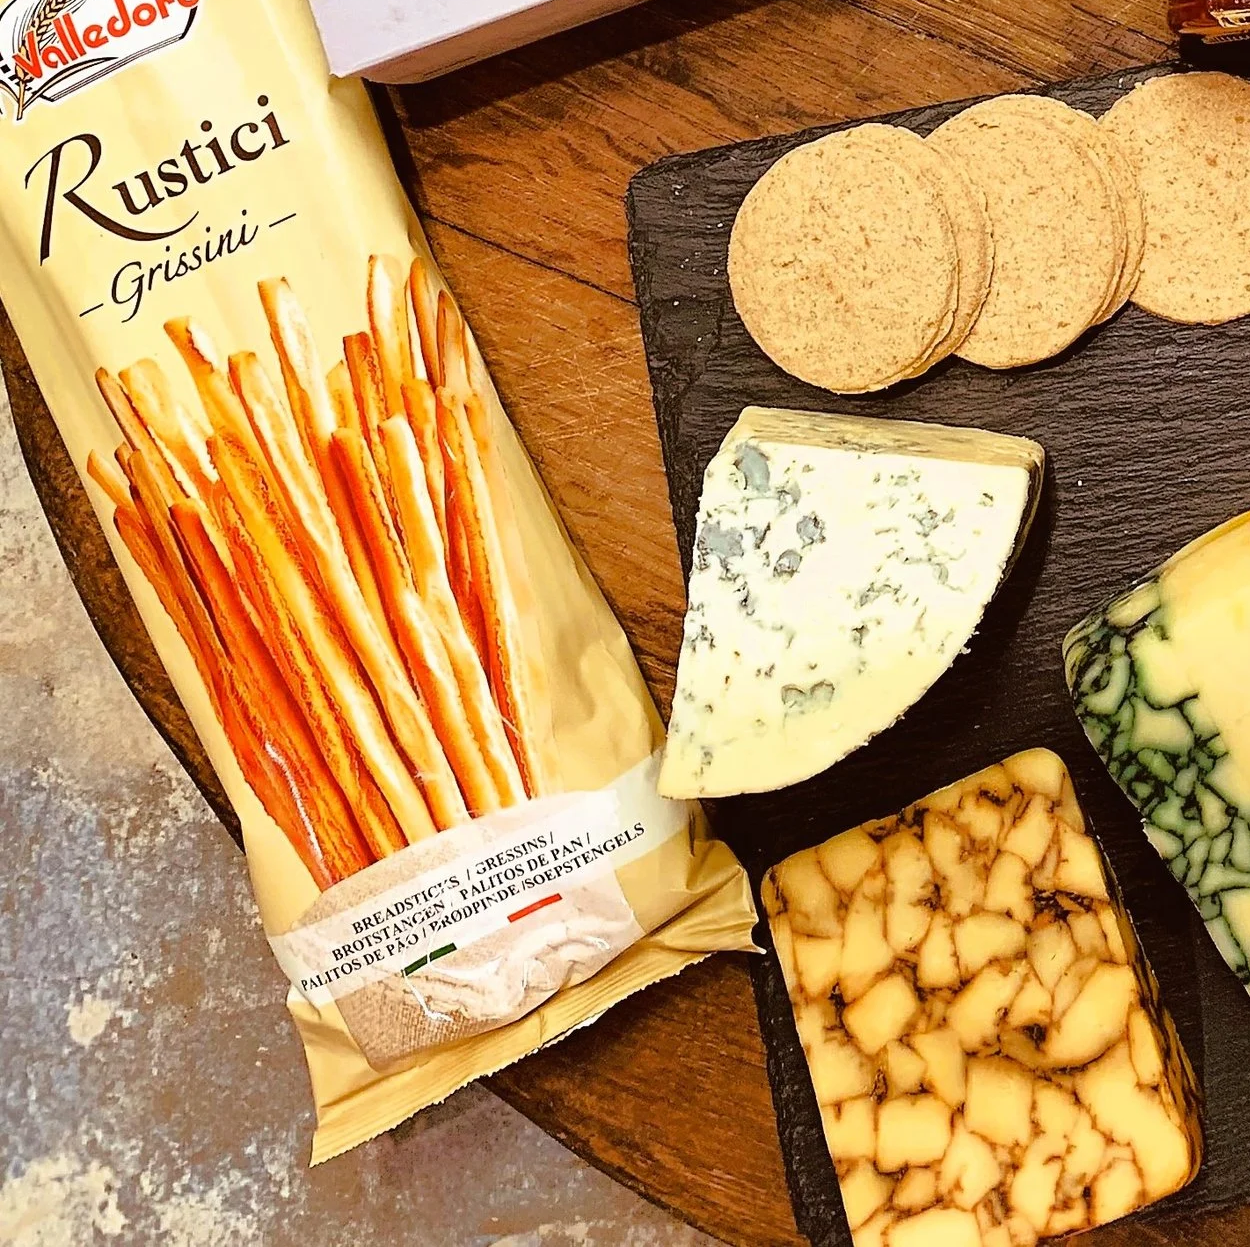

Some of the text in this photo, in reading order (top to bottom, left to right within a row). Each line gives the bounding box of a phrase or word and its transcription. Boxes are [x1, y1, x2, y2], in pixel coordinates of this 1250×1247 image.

[25, 94, 290, 267] Rustici
[110, 208, 259, 323] Grissini
[331, 899, 445, 961] BROTSTANGEN
[459, 866, 526, 901] PALITOS
[528, 855, 549, 876] DE
[551, 839, 585, 865] PAN
[352, 875, 460, 935] BREADSTICKS
[475, 835, 546, 874] GRESSINS
[301, 958, 362, 992] PALITOS
[365, 951, 385, 968] DE
